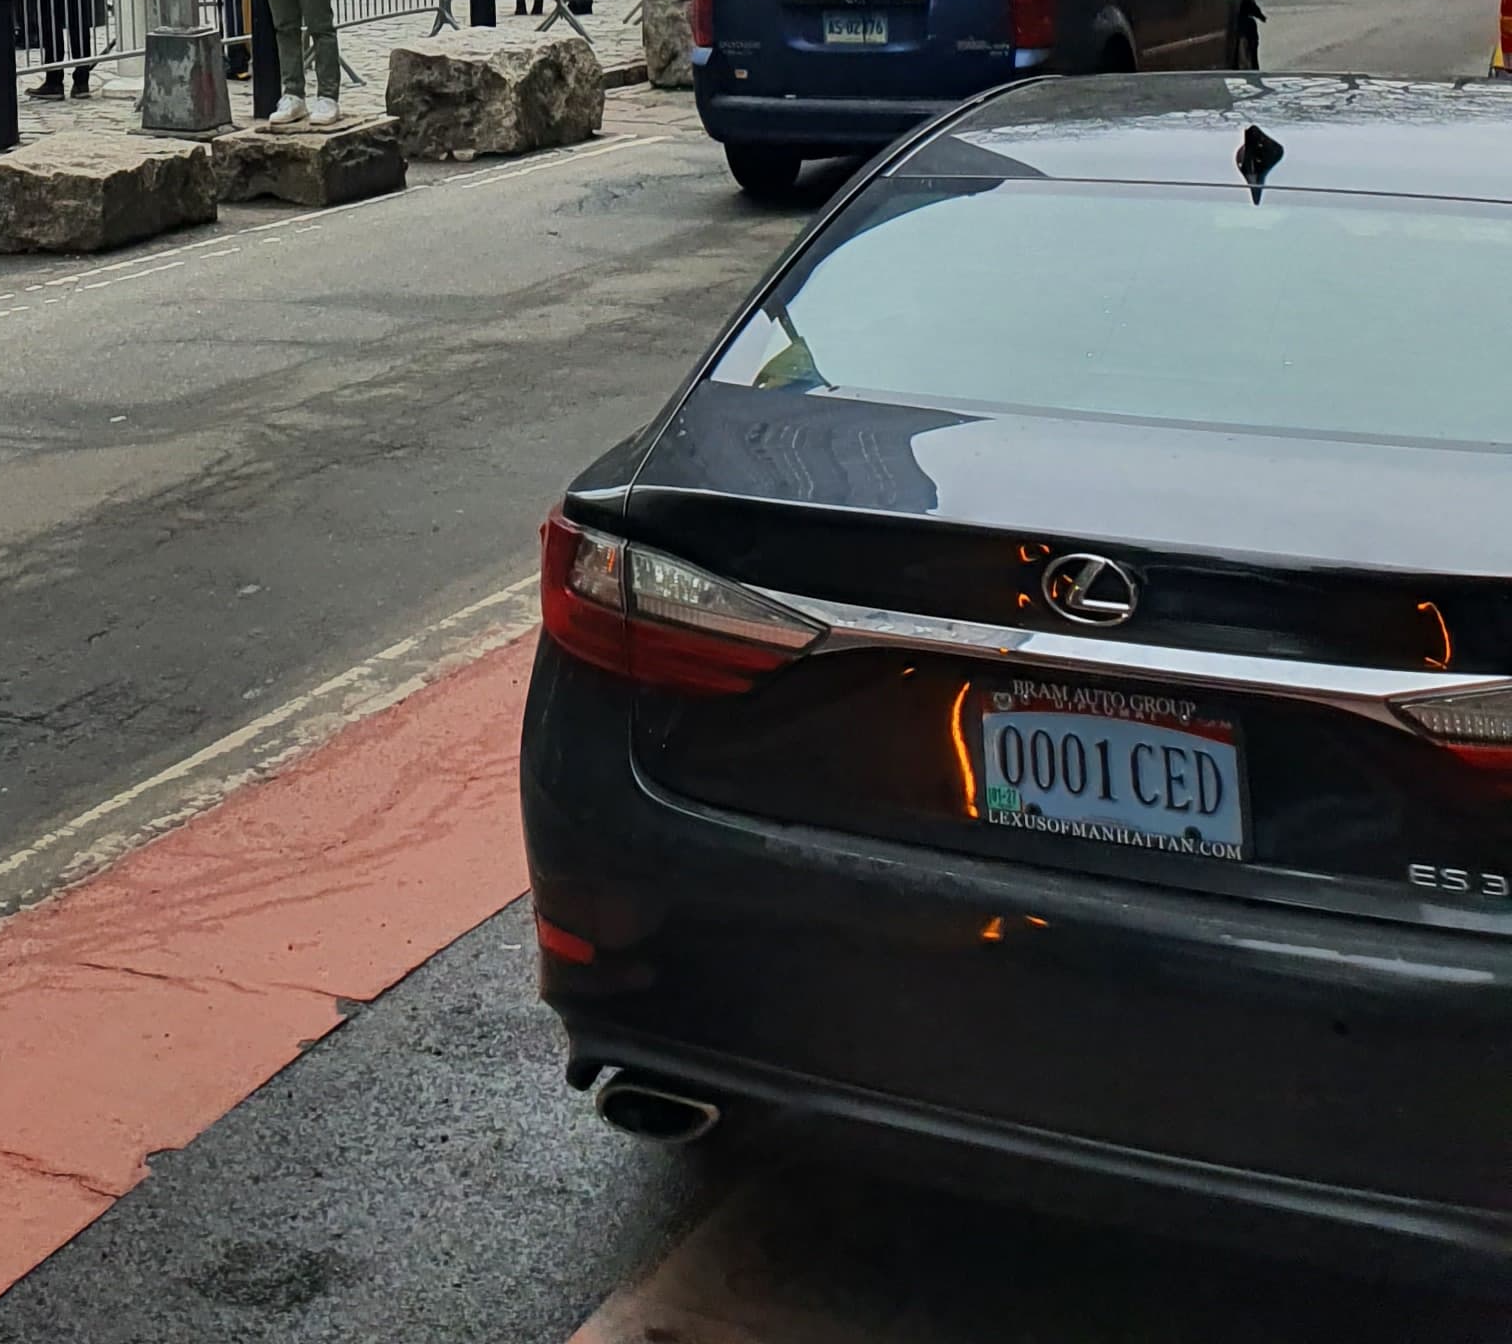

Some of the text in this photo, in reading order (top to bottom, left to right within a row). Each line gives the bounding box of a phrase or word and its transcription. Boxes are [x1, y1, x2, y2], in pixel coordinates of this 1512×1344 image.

[1012, 679, 1196, 717] BRAM AUTO GROUP
[999, 724, 1223, 814] 0001 CED
[1408, 863, 1470, 891] ES
